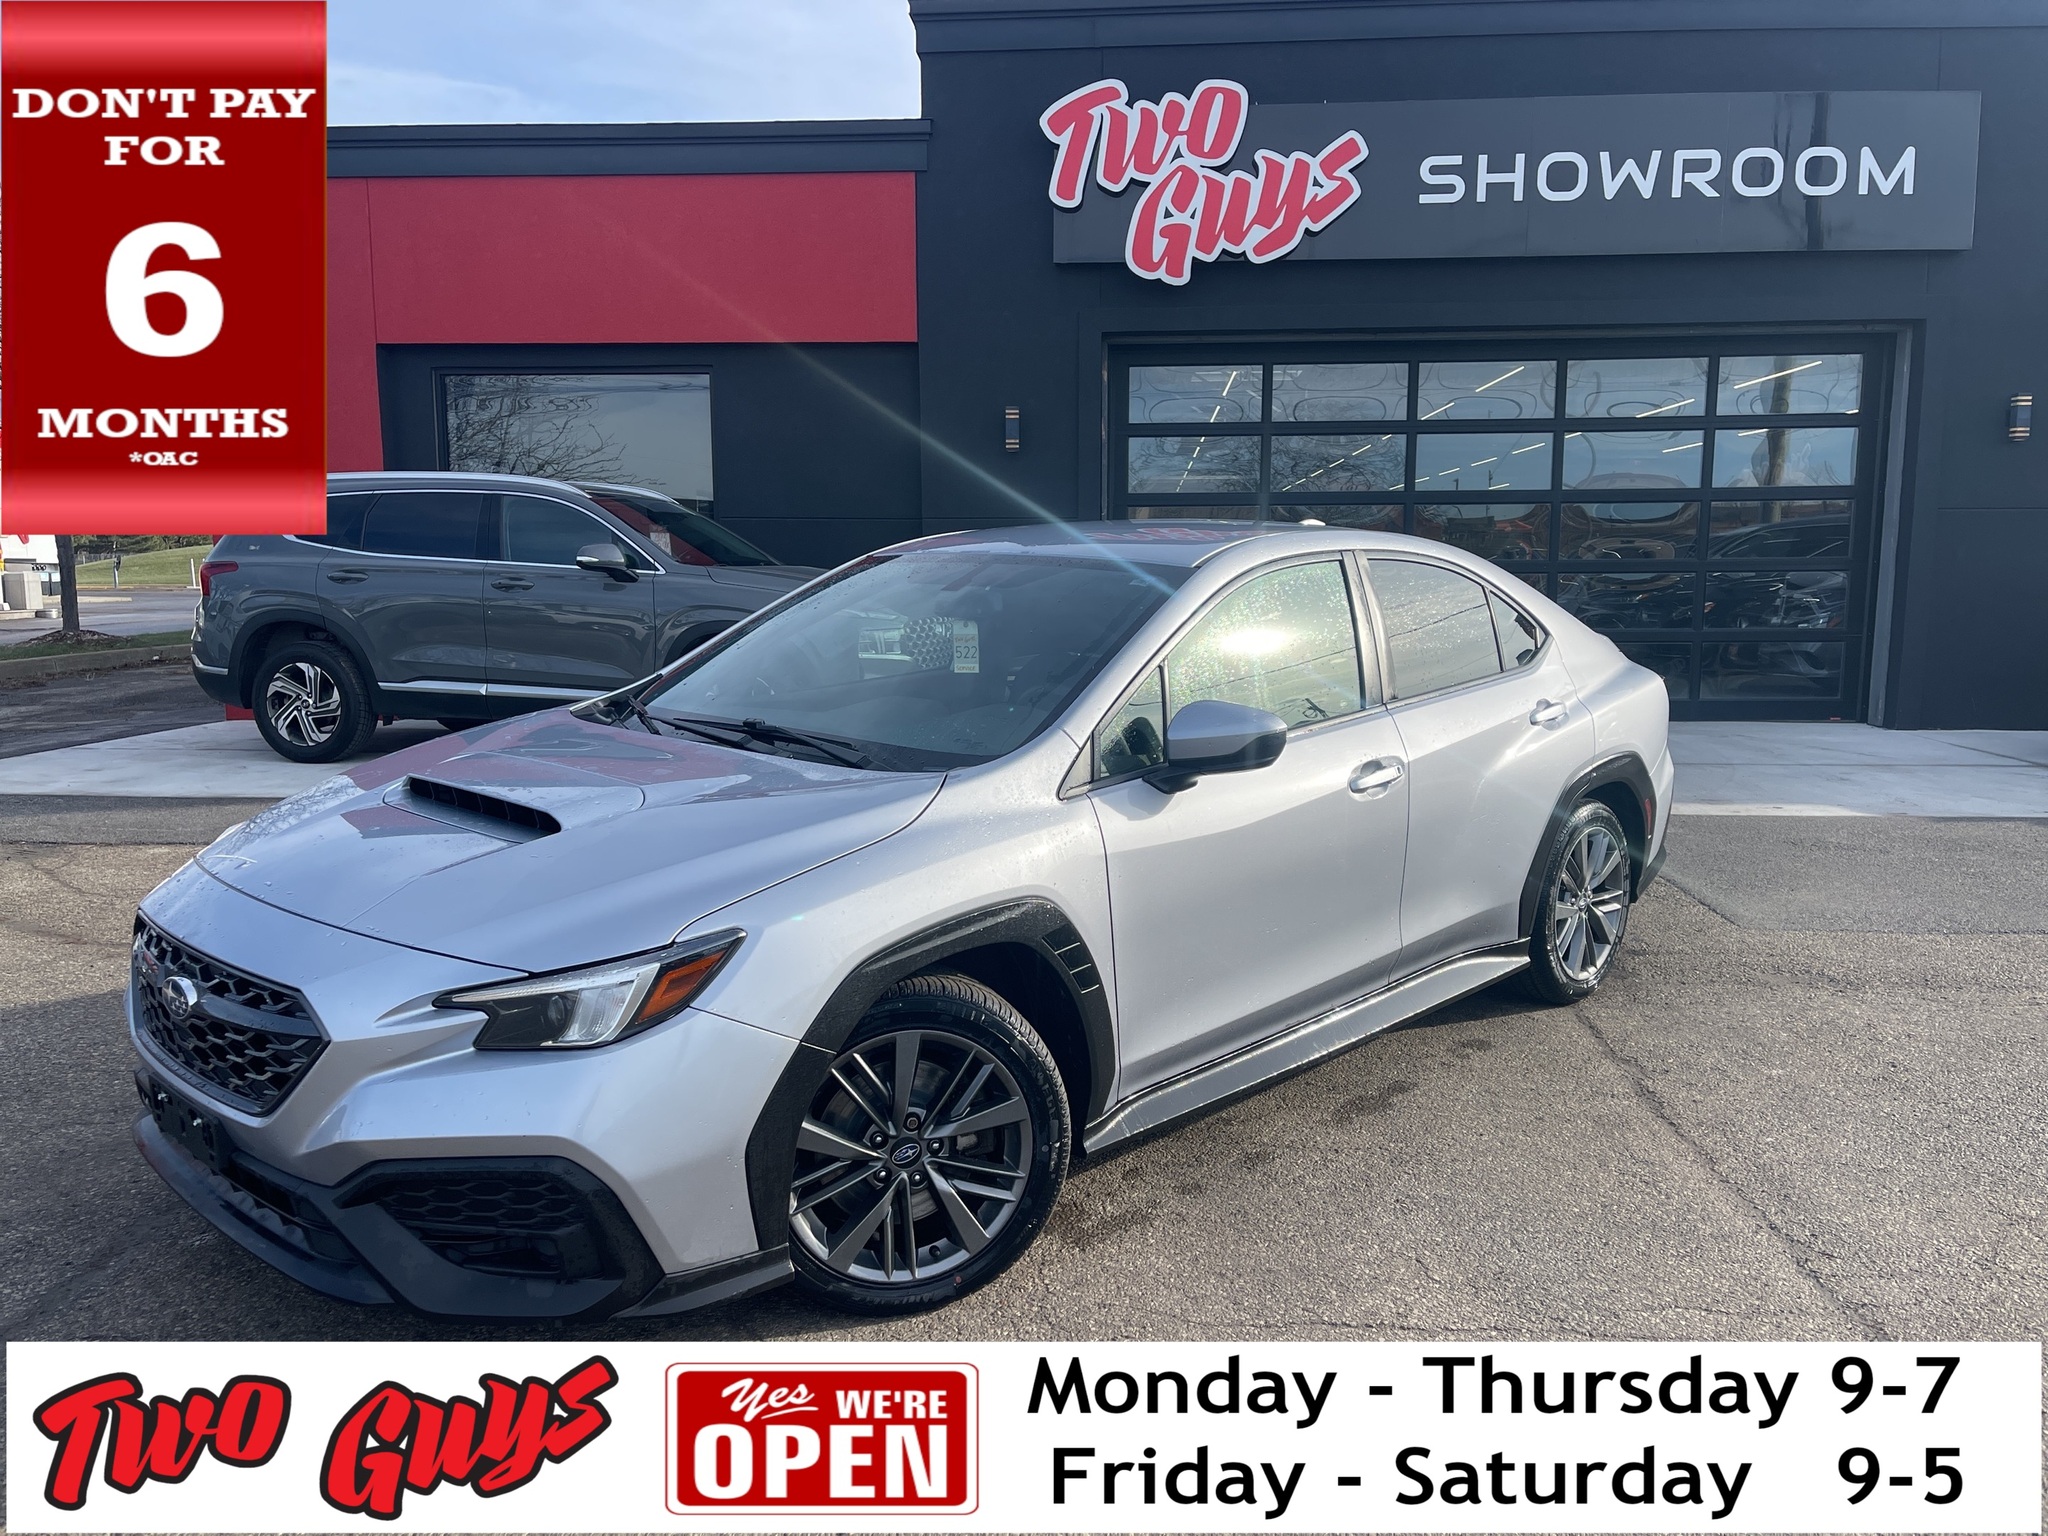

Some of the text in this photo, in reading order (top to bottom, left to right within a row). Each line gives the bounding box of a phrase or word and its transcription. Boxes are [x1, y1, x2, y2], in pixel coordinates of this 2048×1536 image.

[1040, 78, 1249, 208] Two
[1418, 145, 1916, 205] SHOWROOM
[1125, 129, 1369, 286] Guys
[955, 646, 977, 658] 522
